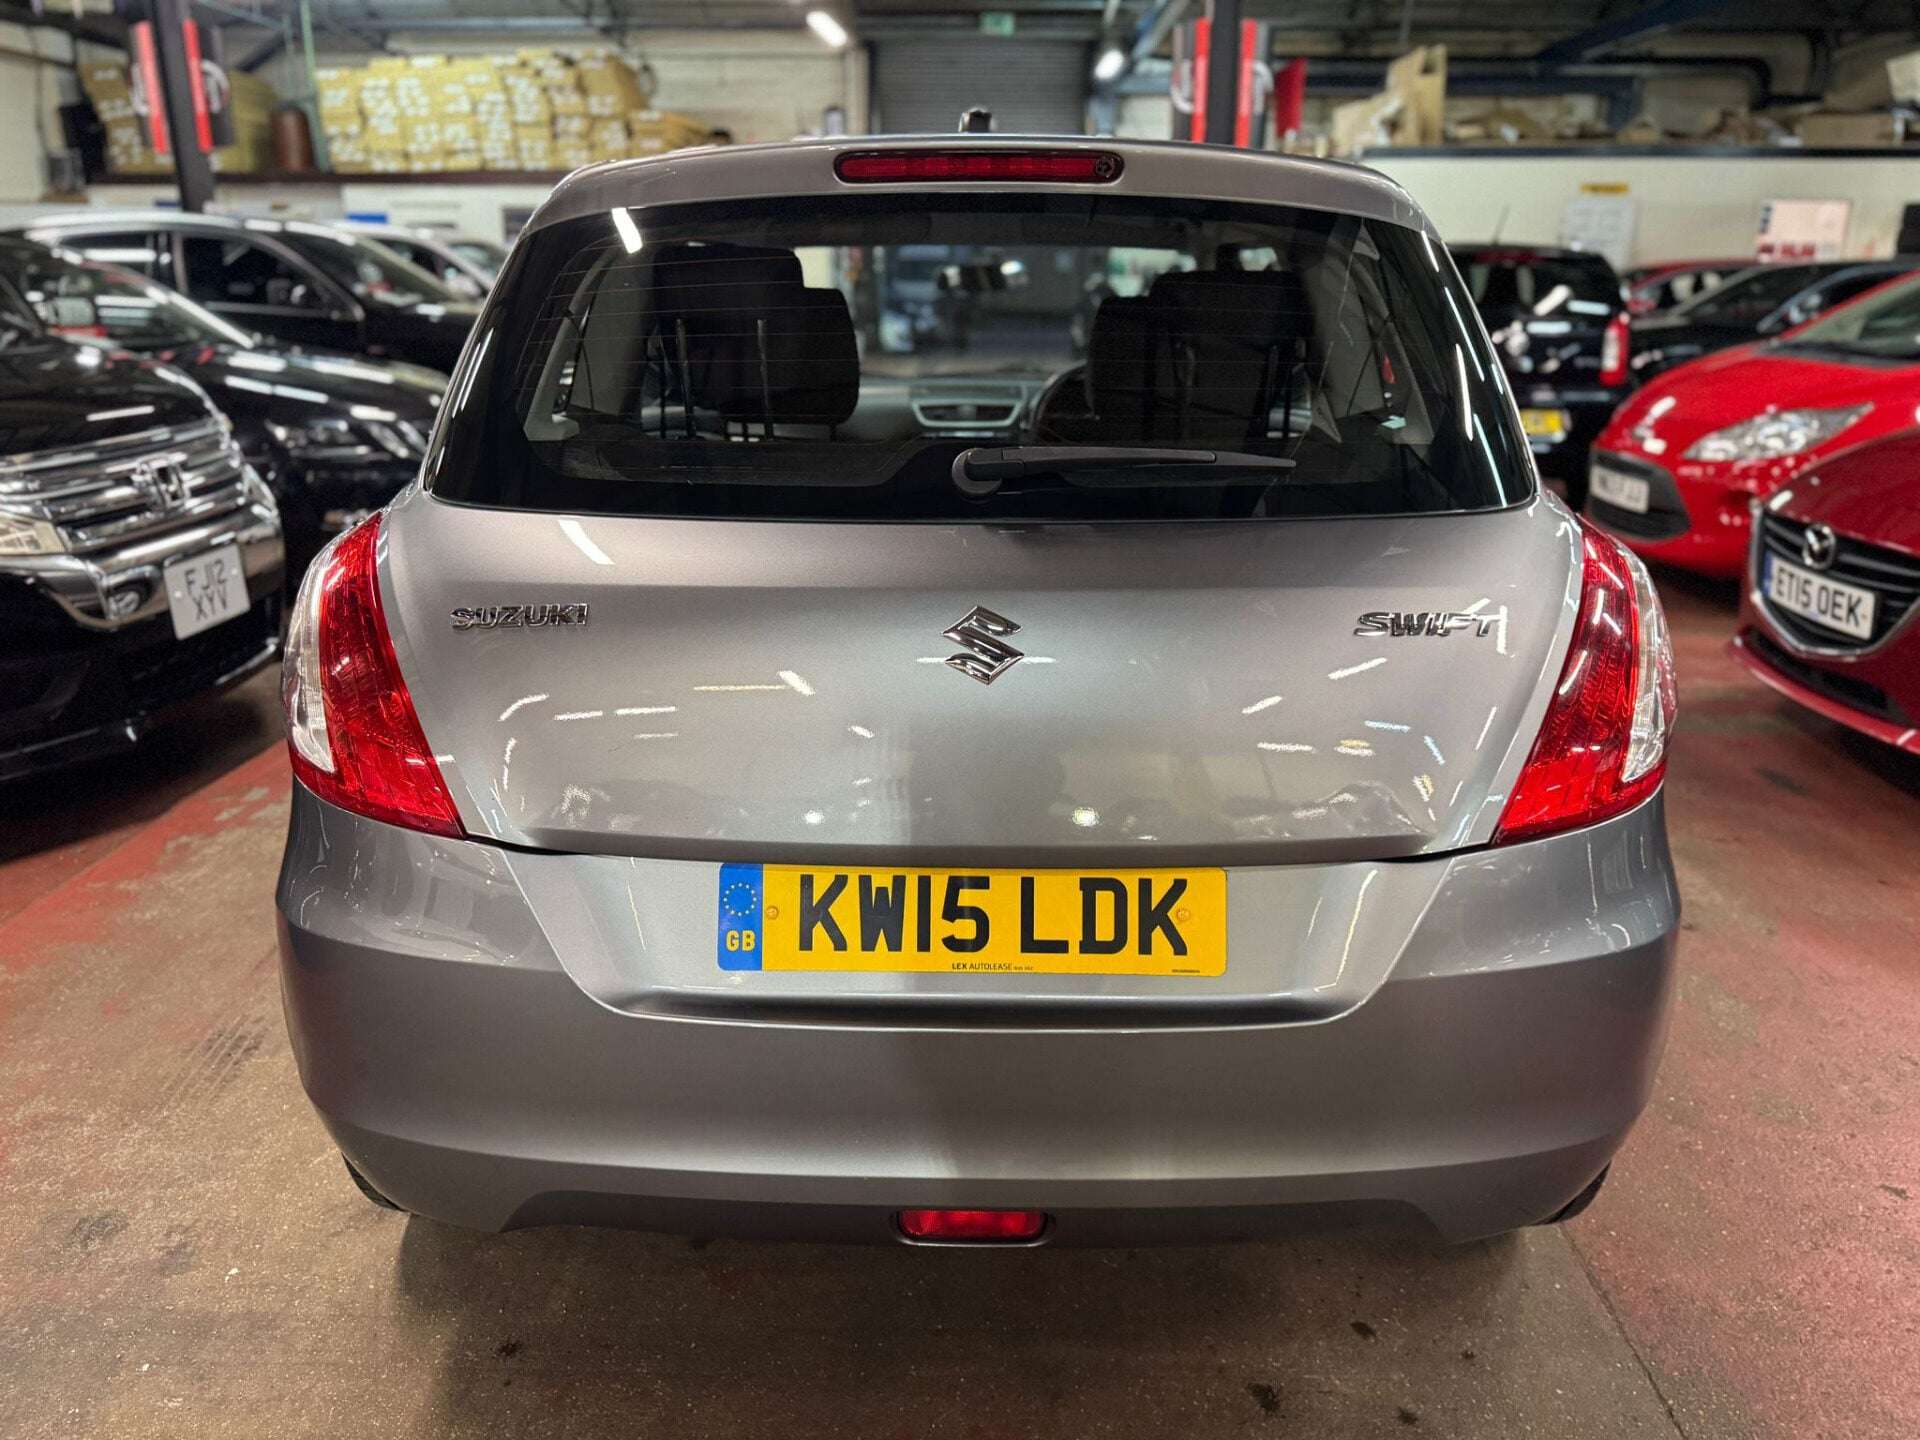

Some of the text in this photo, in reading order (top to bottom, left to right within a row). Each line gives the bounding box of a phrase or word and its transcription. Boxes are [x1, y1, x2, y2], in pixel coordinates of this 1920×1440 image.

[184, 558, 226, 596] FJ12
[193, 586, 227, 620] XYV
[1776, 566, 1862, 628] ET15 OEK
[450, 602, 588, 630] SUZUKI
[1353, 611, 1501, 637] SWIFT
[798, 874, 1188, 956] KW15 LDK
[726, 929, 756, 951] GB
[951, 962, 967, 971] LEX
[968, 962, 1012, 971] AUTOLEASE
